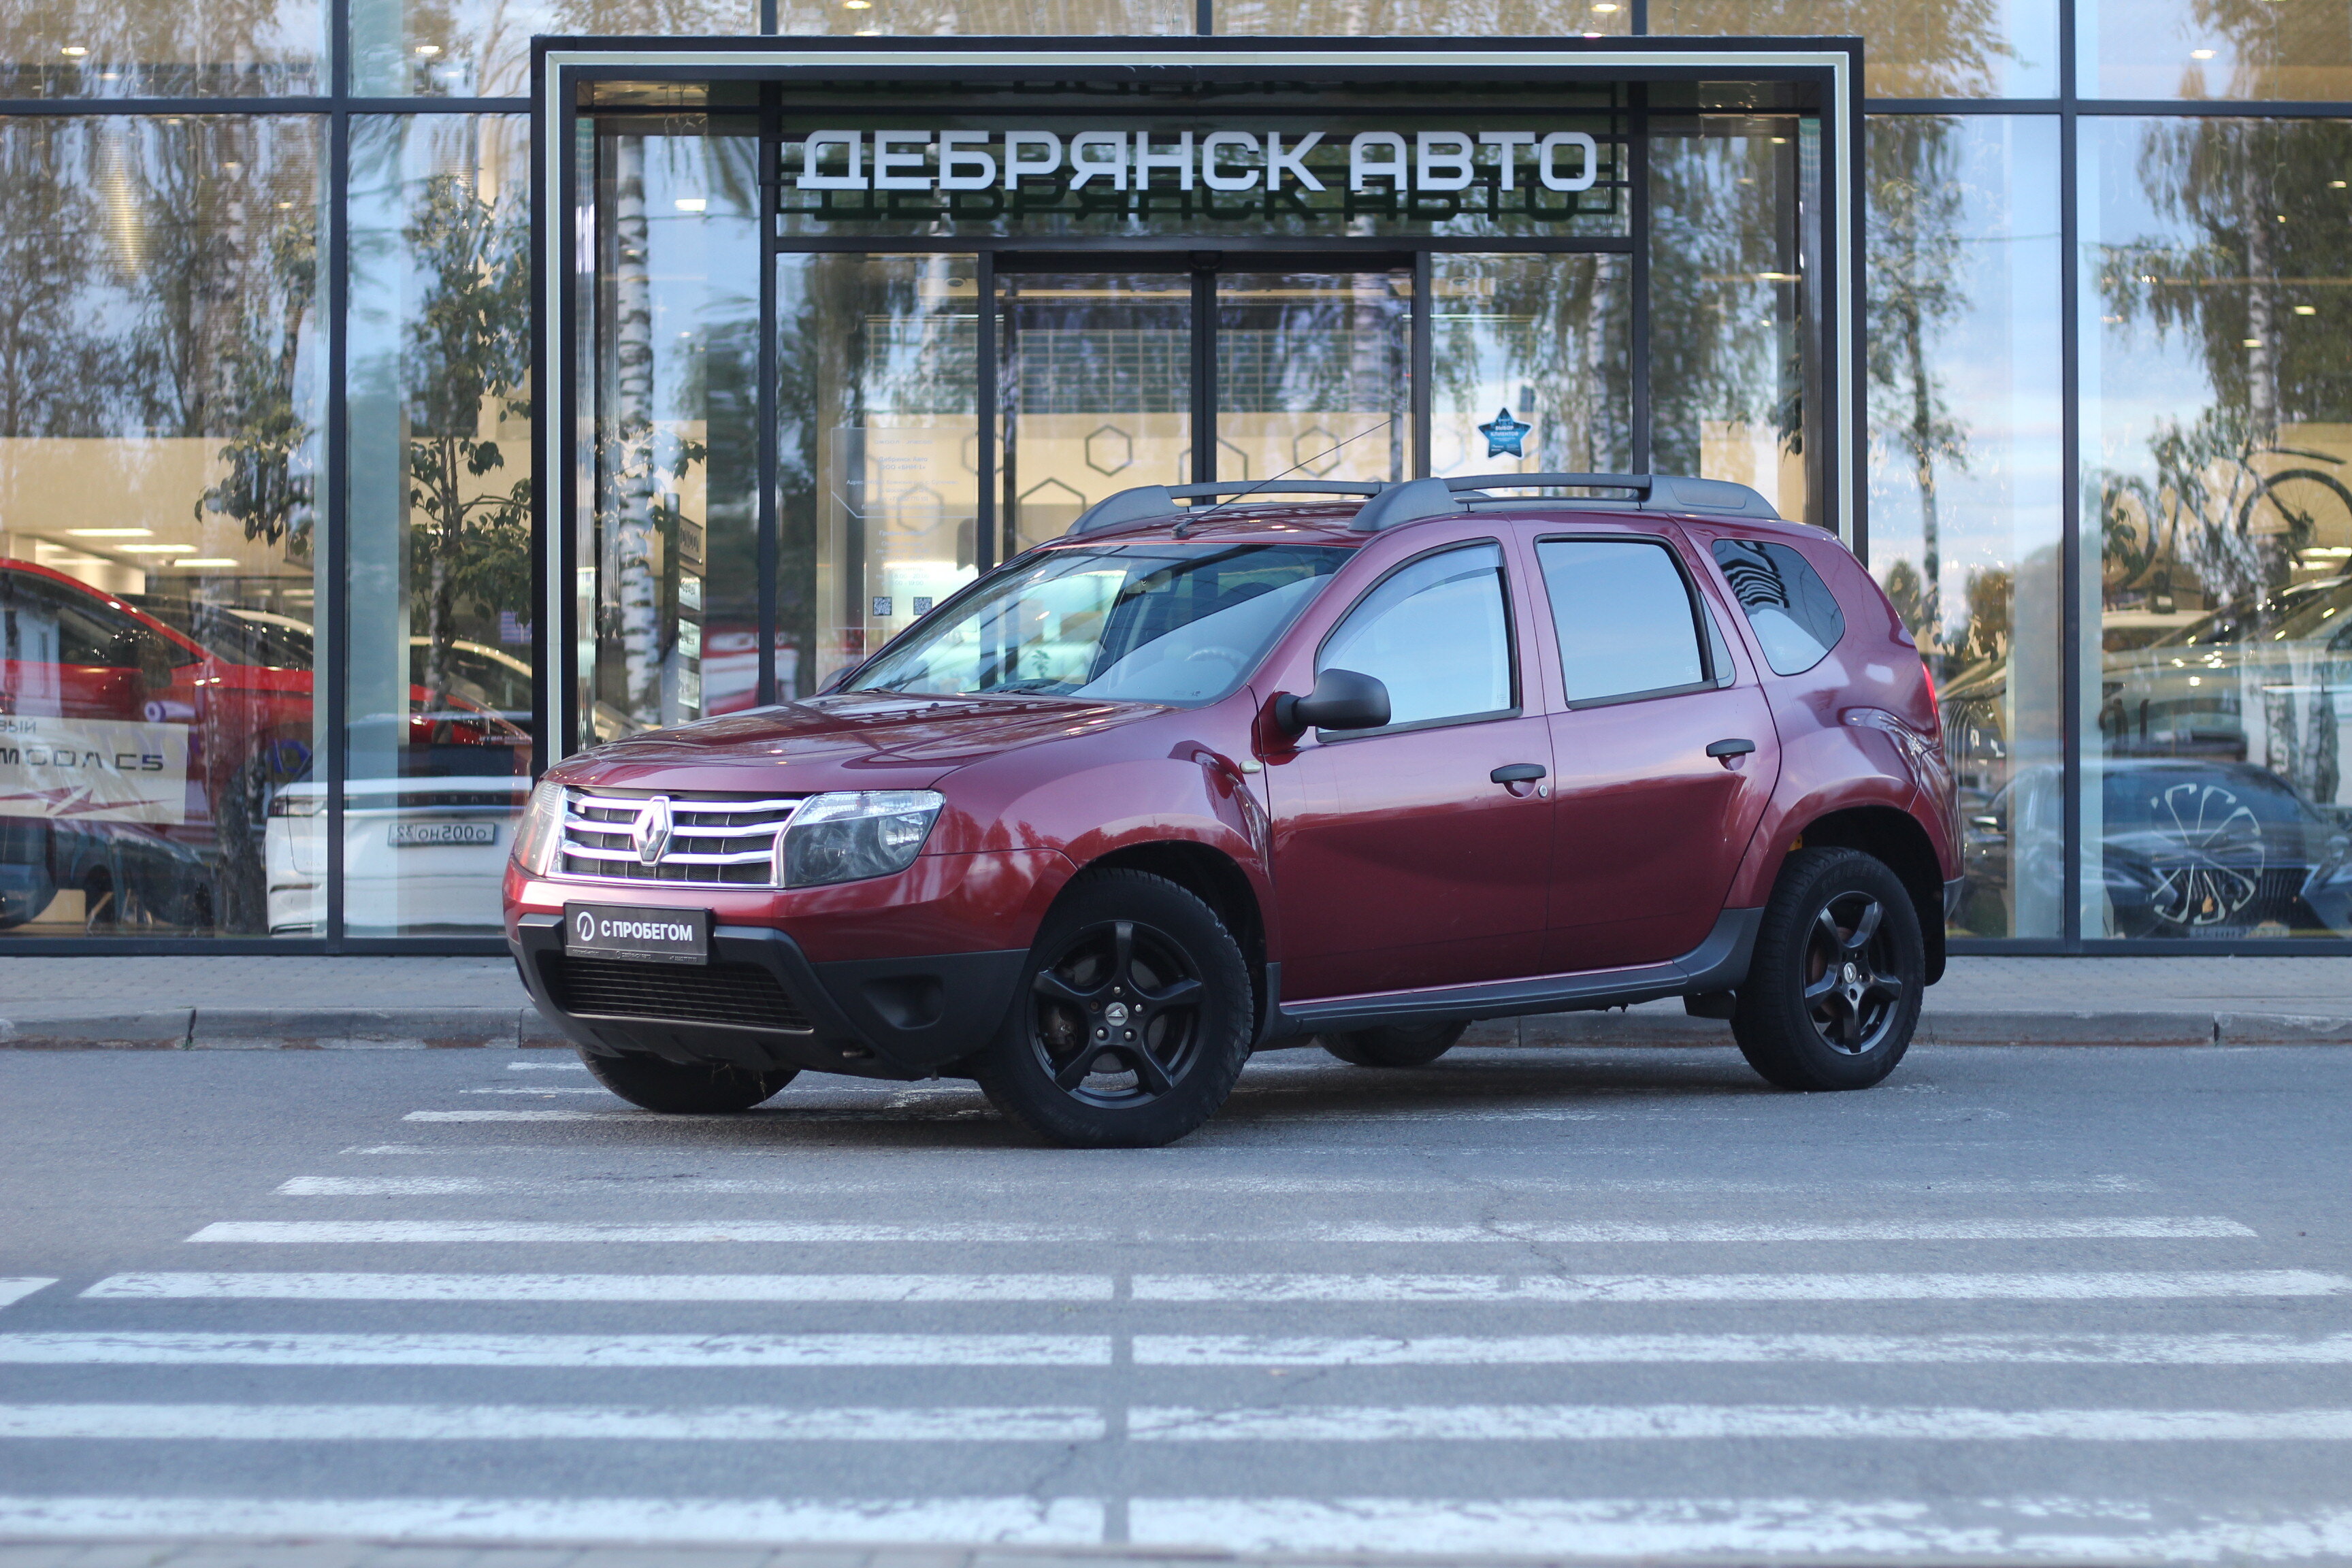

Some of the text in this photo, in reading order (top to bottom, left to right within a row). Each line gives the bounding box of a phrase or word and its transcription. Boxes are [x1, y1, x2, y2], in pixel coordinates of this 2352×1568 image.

[796, 130, 1598, 191] ДЕБРЯНСК АВТО
[114, 753, 164, 771] C5
[600, 920, 693, 941] С ПРОБЕГОМ
